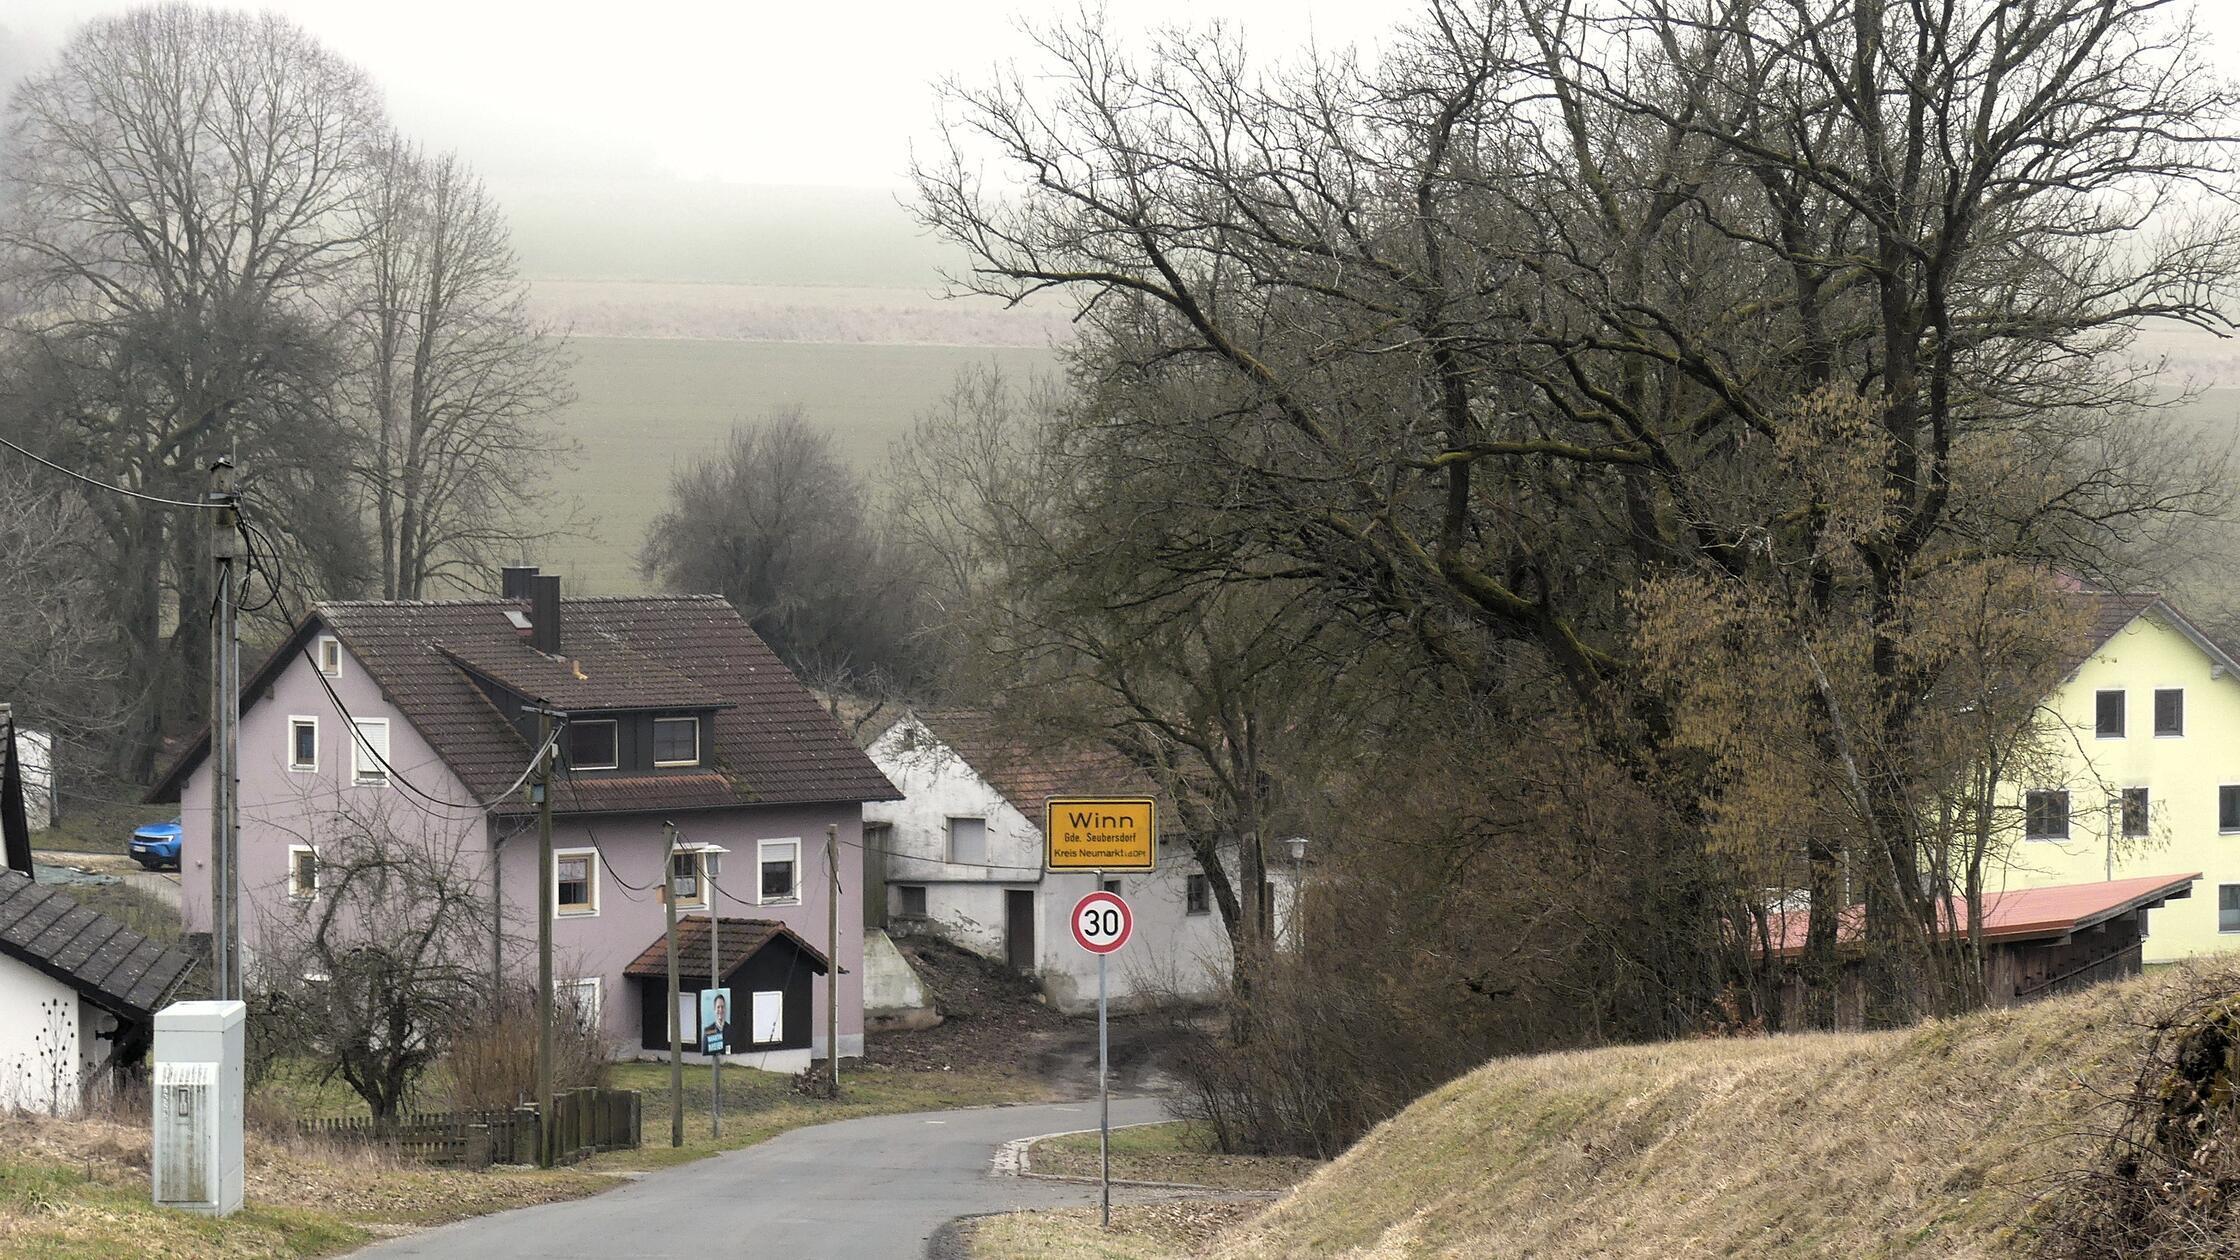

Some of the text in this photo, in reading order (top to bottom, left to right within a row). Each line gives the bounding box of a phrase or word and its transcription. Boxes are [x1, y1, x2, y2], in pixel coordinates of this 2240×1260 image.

[1069, 812, 1133, 828] Winn
[1064, 832, 1137, 843] Gde. Seubersdorf
[1054, 848, 1077, 858] Kreis
[1079, 848, 1124, 858] Neumarkt
[1084, 909, 1119, 937] 30
